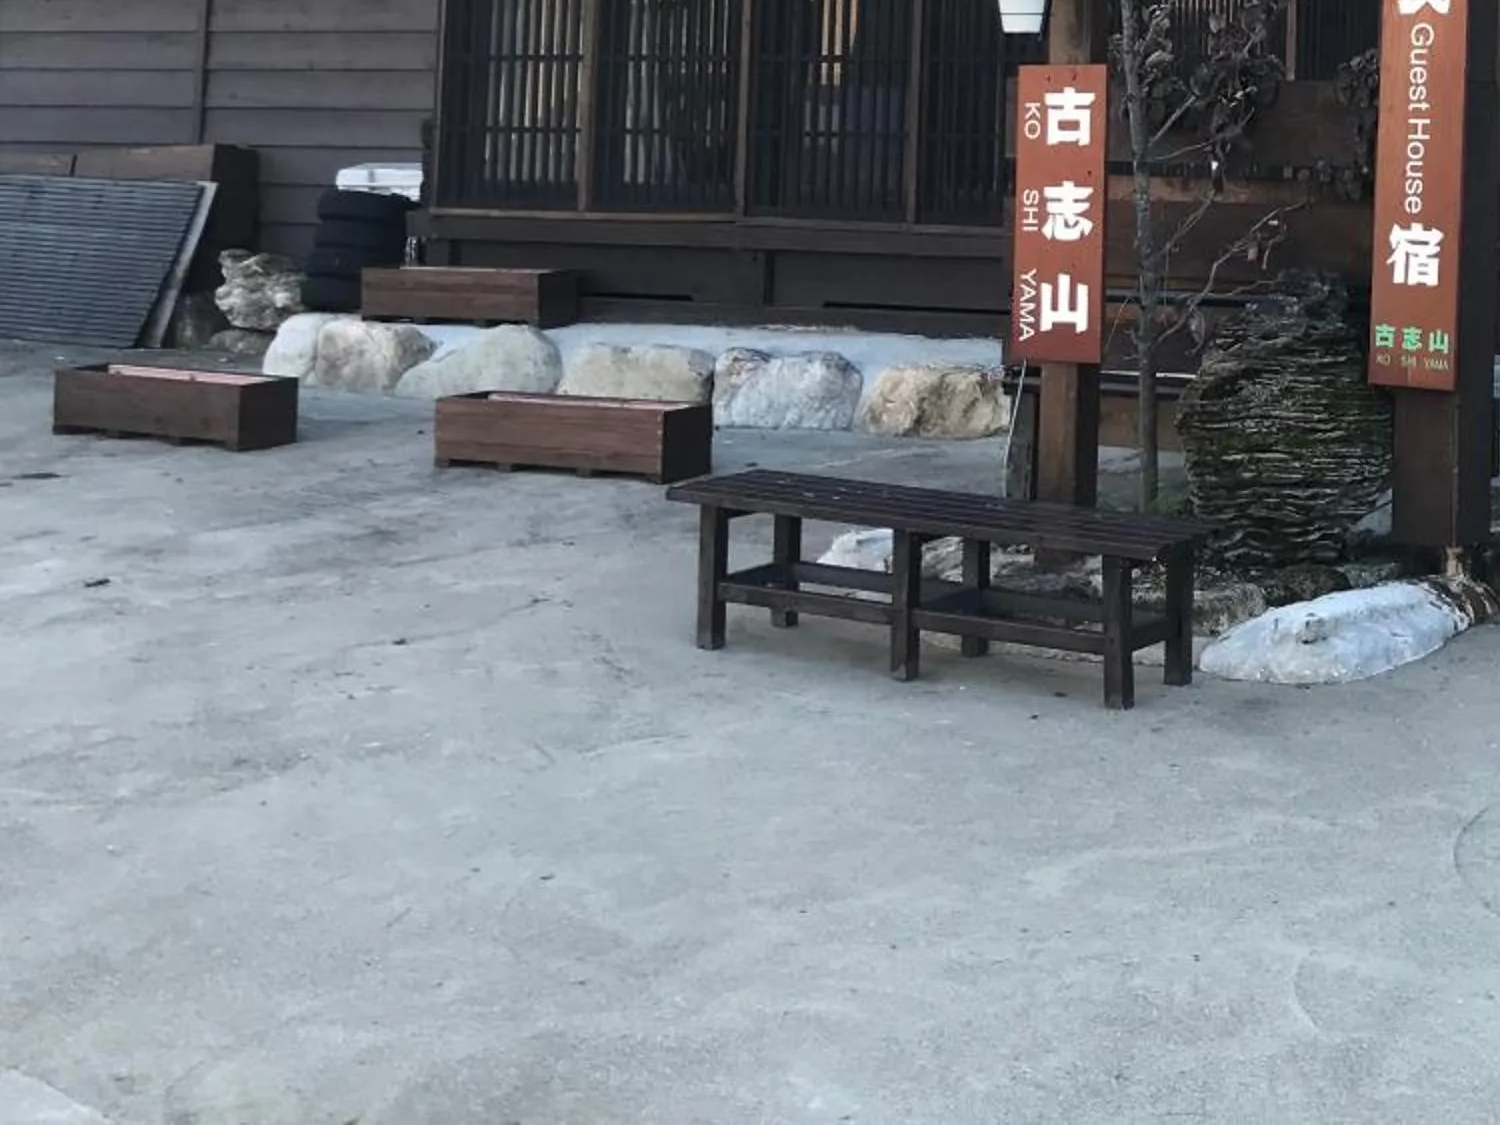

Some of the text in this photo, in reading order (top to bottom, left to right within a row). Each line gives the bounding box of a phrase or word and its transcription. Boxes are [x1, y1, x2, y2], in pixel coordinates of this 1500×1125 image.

[1040, 86, 1096, 334] 古志山
[1404, 22, 1435, 214] Guest House
[1018, 102, 1041, 342] KO SHI YAMA
[1386, 222, 1445, 286] 宿
[1375, 323, 1449, 354] 古志山
